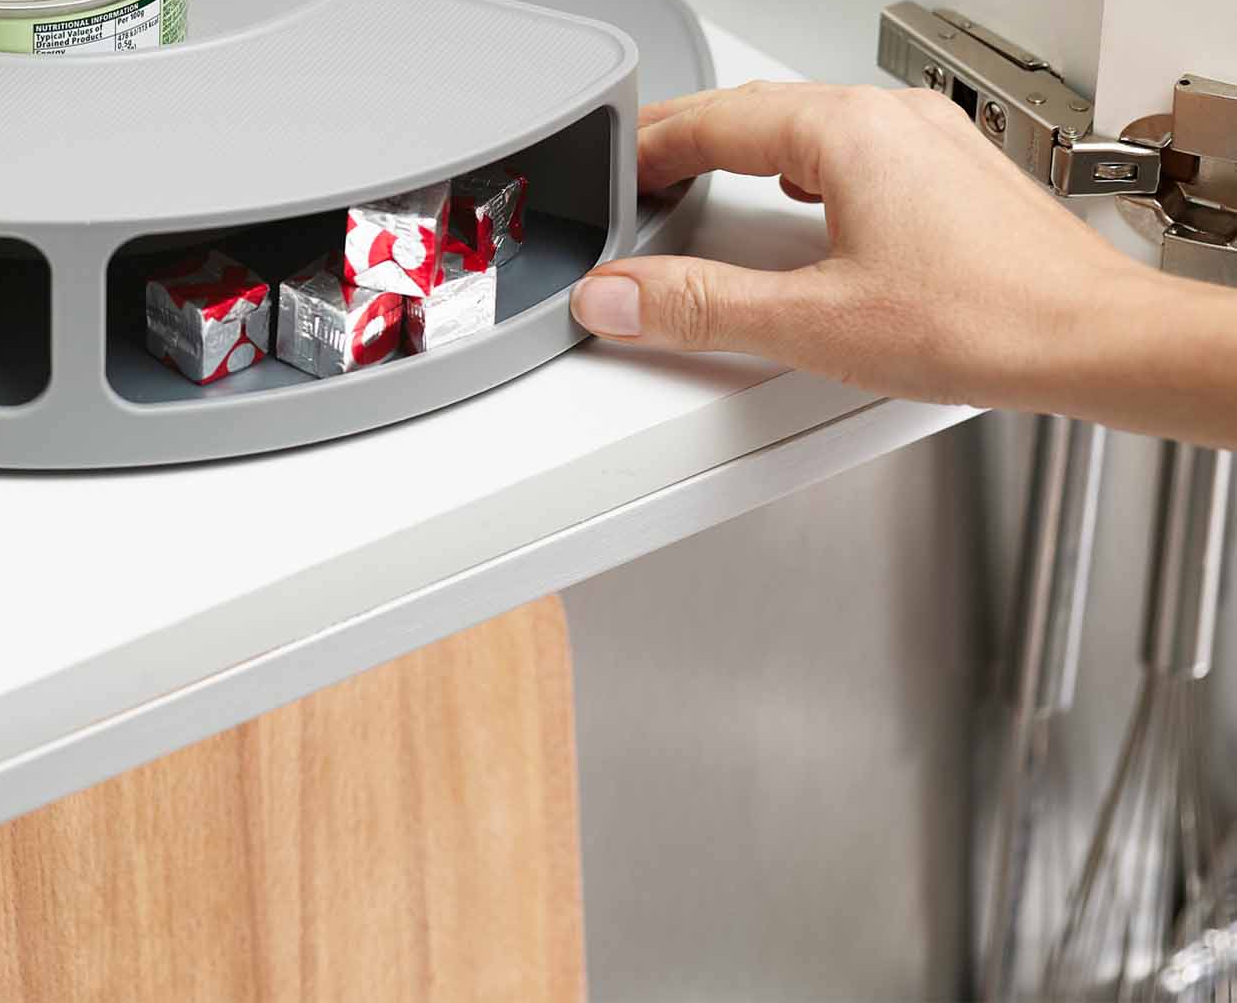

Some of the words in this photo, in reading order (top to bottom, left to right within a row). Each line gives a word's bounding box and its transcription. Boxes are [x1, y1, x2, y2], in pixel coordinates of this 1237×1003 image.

[35, 20, 89, 32] NUTRITIONAL
[90, 3, 139, 24] INFORMATION
[117, 16, 129, 25] Per
[130, 9, 145, 20] 100g
[36, 31, 65, 42] Typical
[67, 27, 93, 36] Values
[94, 24, 103, 32] of
[36, 38, 70, 48] Drained
[71, 32, 103, 44] Product
